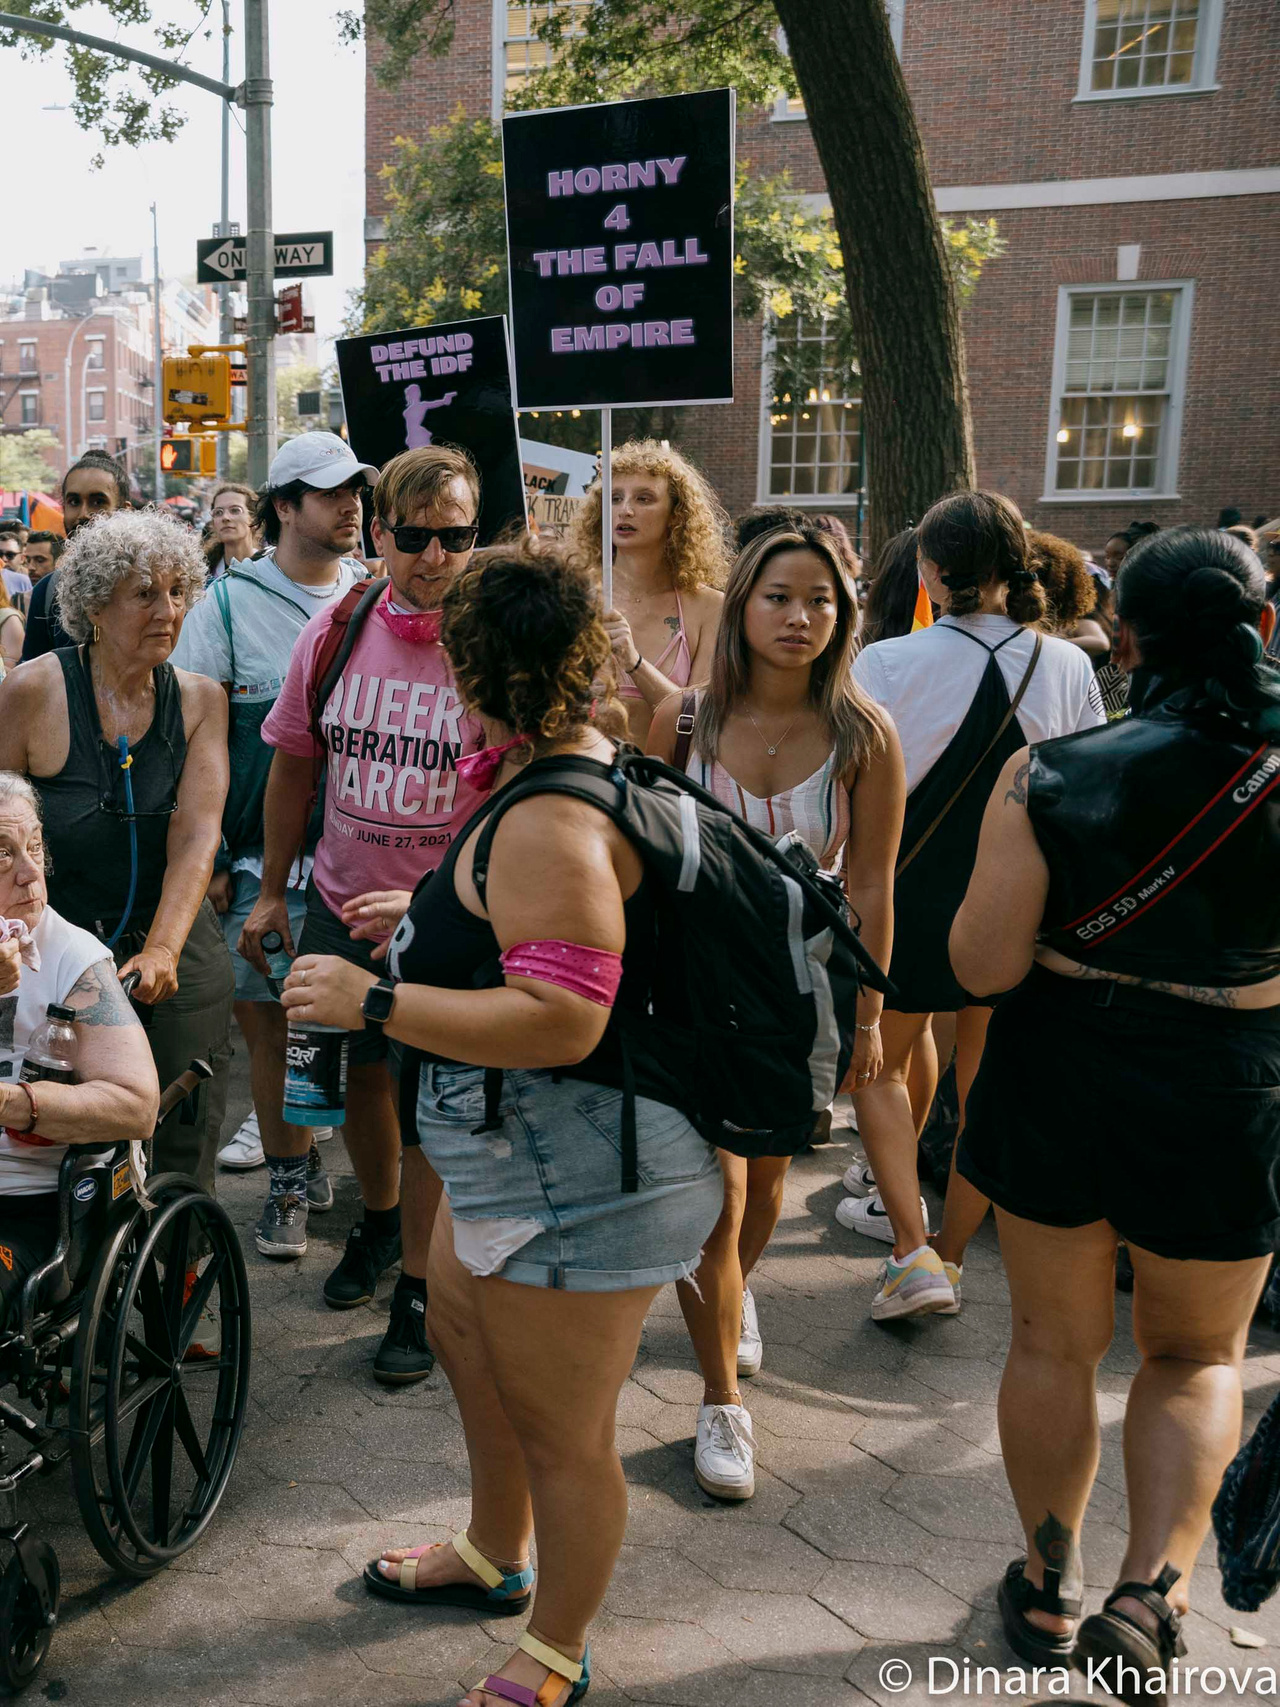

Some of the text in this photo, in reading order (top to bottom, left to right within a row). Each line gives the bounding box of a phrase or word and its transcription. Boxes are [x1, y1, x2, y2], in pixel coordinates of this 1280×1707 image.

[547, 156, 687, 197] HORNY
[604, 204, 631, 231] 4
[217, 245, 315, 269] ON WAY
[533, 237, 709, 278] THE FALL
[595, 282, 645, 311] OF
[370, 332, 474, 364] DEFUND
[550, 319, 696, 353] EMPIRE
[375, 353, 474, 384] THE IDF
[524, 473, 557, 493] LACK
[1232, 754, 1280, 803] Canon
[356, 829, 390, 847] JUNE
[394, 837, 415, 850] 27,
[418, 832, 453, 847] 2021
[1075, 865, 1176, 940] EOS 5D Mark IV
